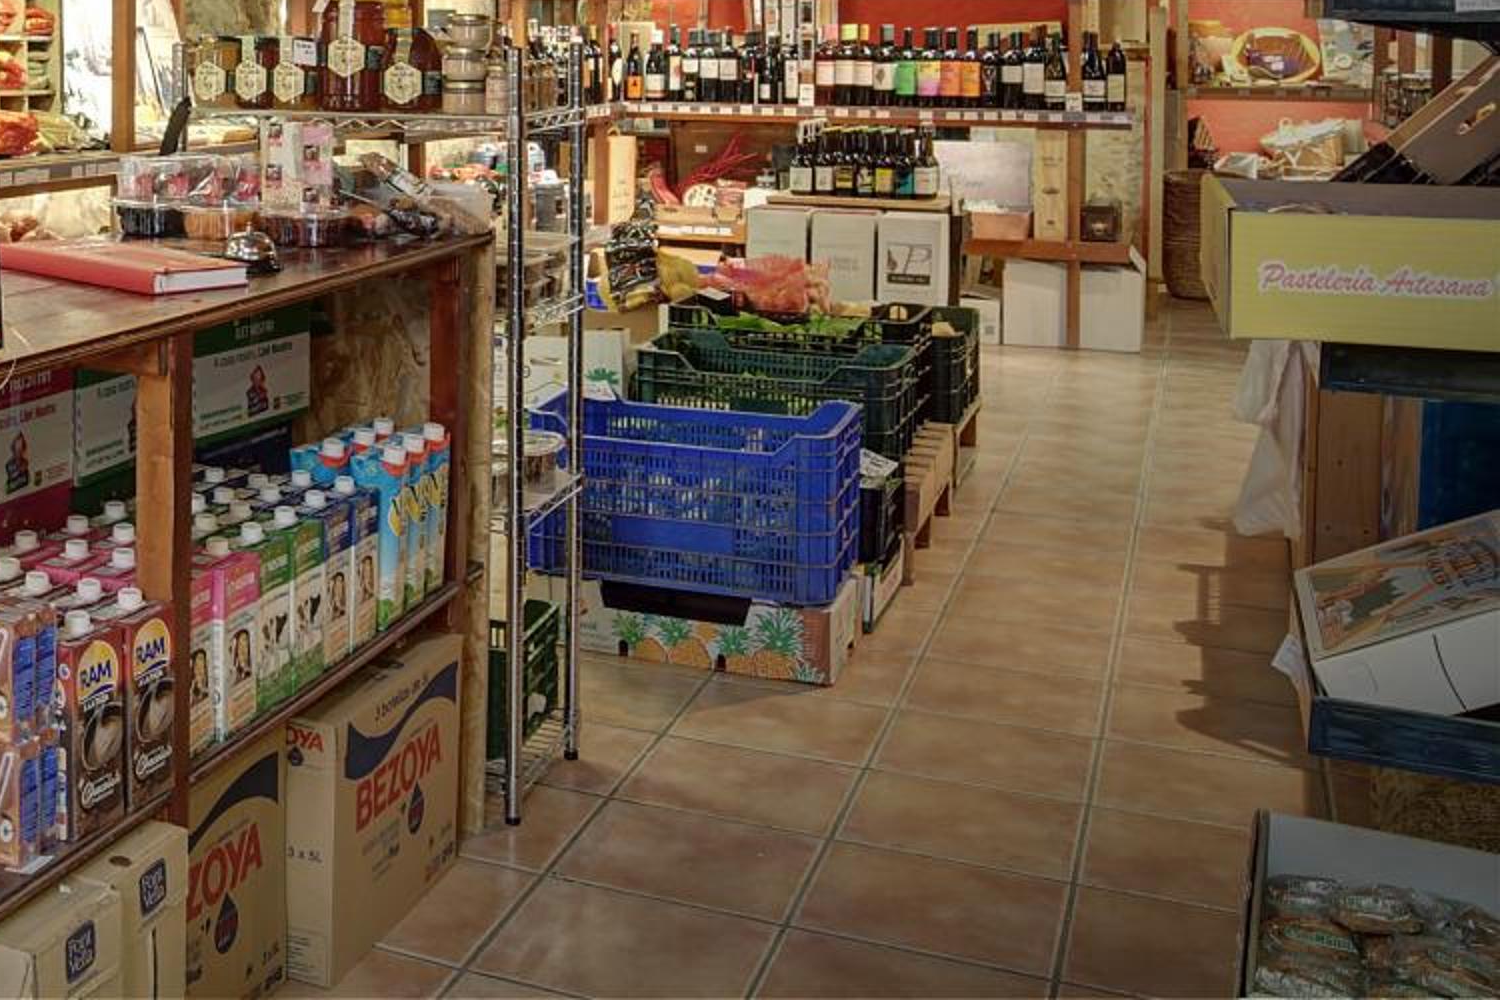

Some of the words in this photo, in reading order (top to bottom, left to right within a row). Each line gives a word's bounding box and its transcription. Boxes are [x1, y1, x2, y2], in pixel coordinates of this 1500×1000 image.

[1384, 266, 1489, 298] Artesana
[136, 636, 165, 664] RAM
[79, 659, 112, 688] RAM
[286, 724, 325, 752] OYA
[355, 723, 441, 833] BEZOYA
[187, 823, 263, 921] ZOYA
